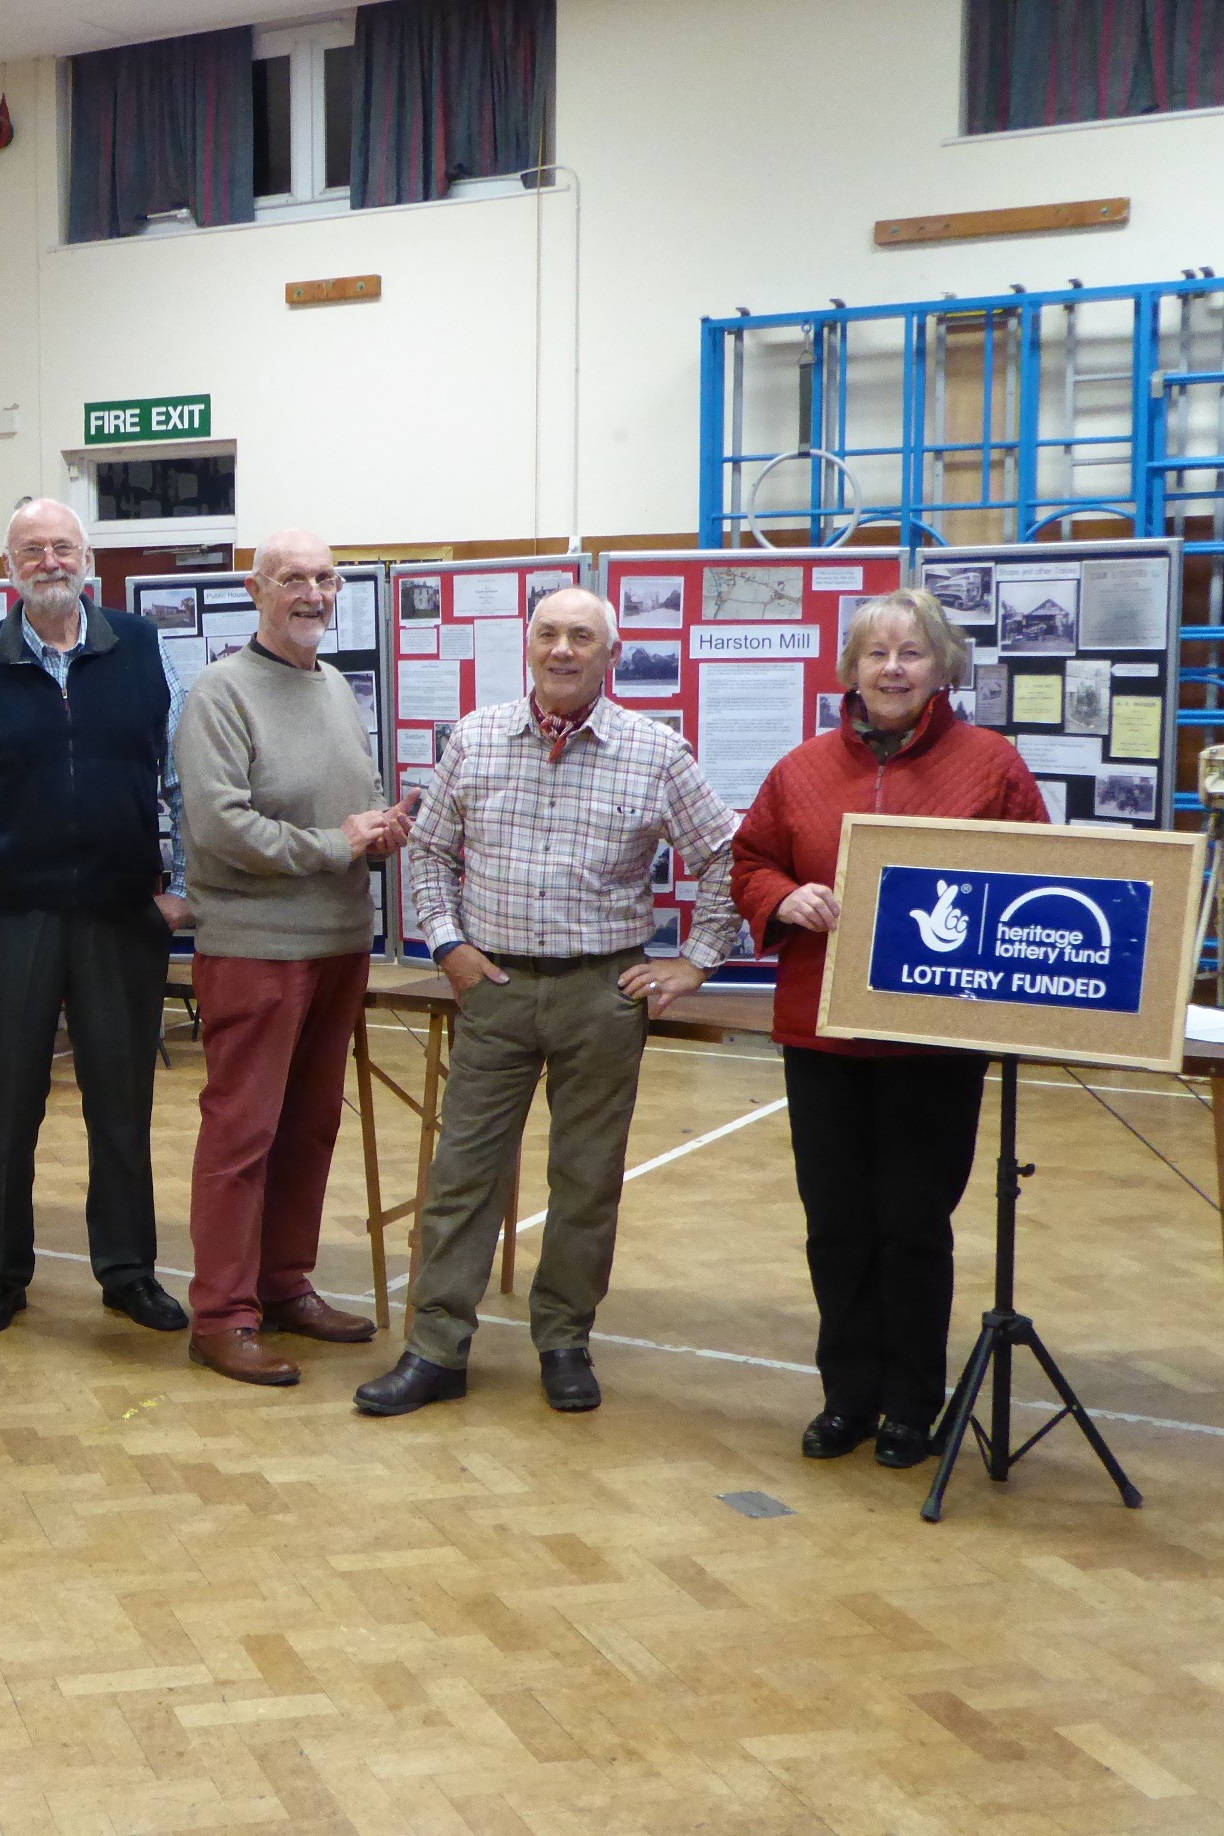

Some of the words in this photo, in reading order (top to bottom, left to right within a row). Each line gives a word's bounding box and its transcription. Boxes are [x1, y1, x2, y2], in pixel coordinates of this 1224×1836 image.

[90, 409, 140, 435] FIRE
[151, 404, 205, 432] EXIT
[206, 592, 226, 600] Public
[699, 634, 772, 650] Harston
[779, 633, 811, 649] Mill
[996, 923, 1083, 948] heritage
[995, 941, 1060, 964] lottery
[1063, 947, 1111, 965] fund
[901, 964, 1004, 991] LOTTERY
[1011, 973, 1107, 999] FUNDED
